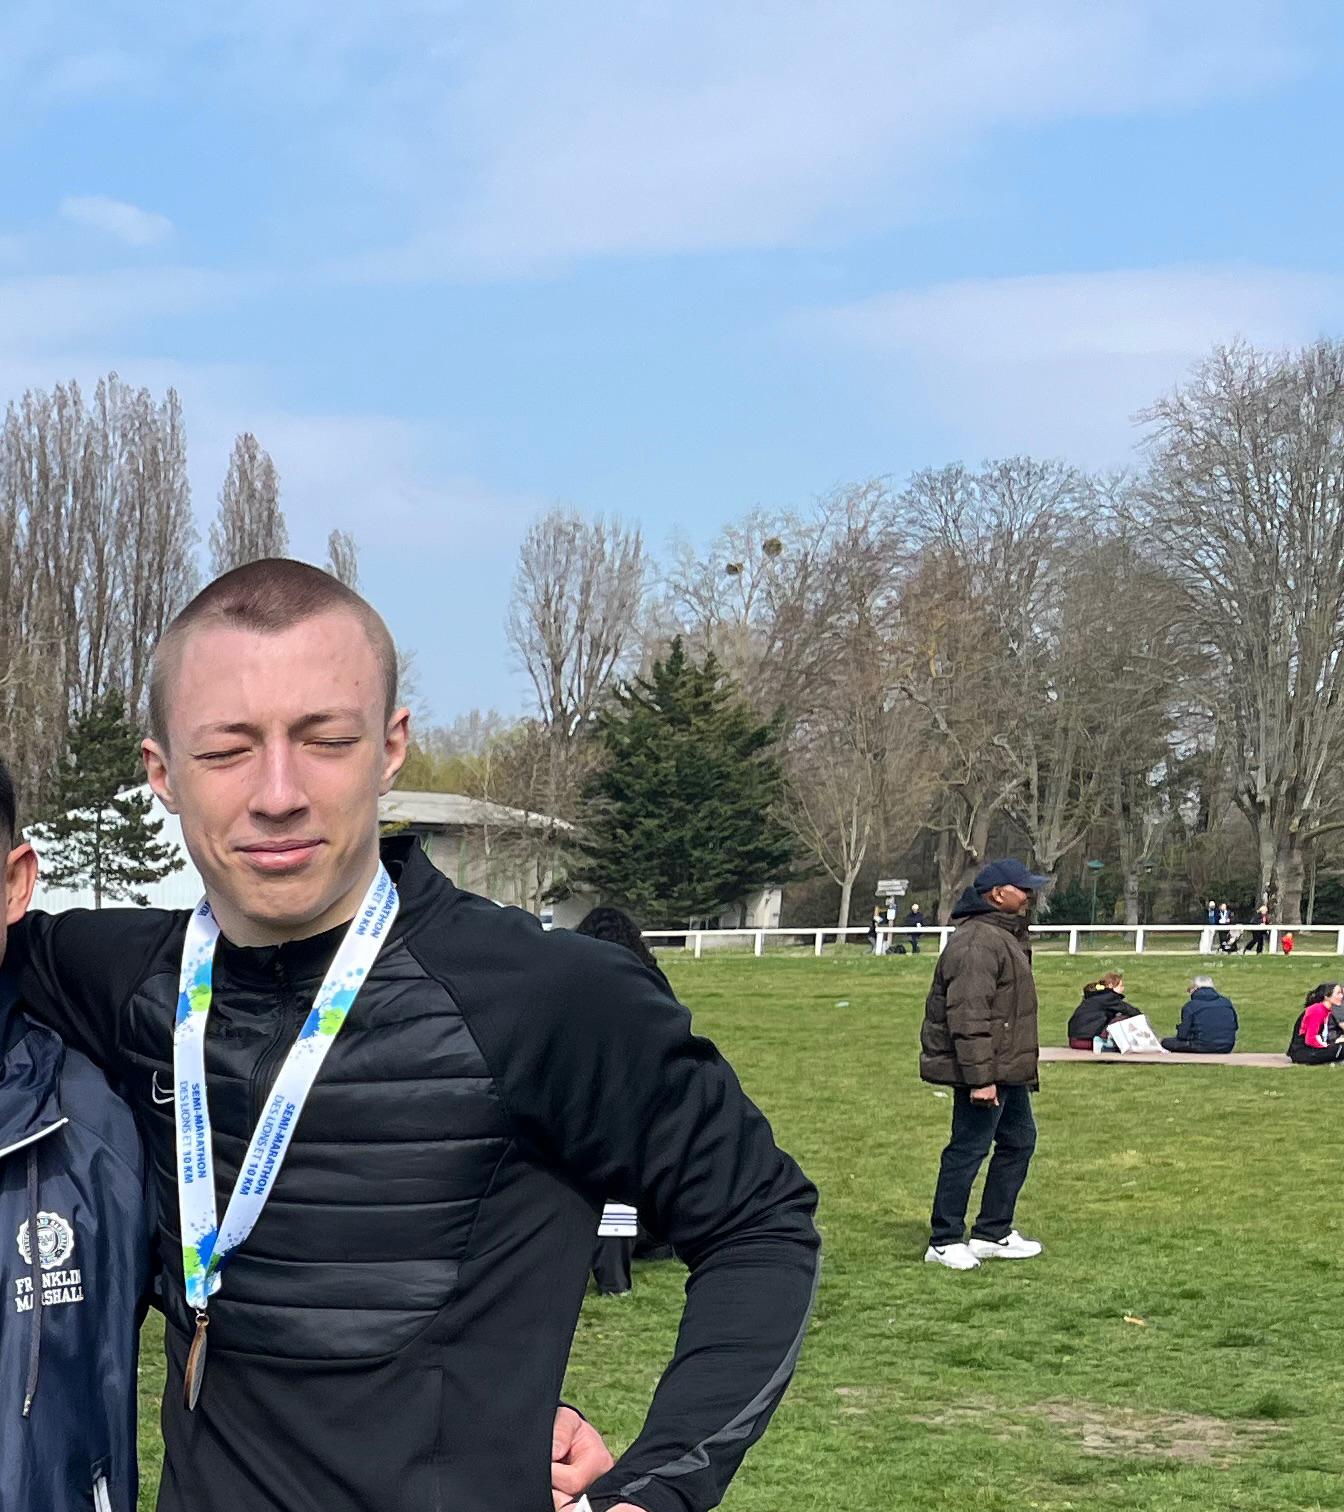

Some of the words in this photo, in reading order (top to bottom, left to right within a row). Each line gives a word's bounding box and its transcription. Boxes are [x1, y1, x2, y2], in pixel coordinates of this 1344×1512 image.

[180, 1080, 190, 1102] DES
[272, 1094, 285, 1116] DES
[180, 1102, 192, 1135] LIONS
[182, 1135, 192, 1148] ET
[192, 1082, 208, 1180] SEMI-MARATHON
[257, 1115, 276, 1147] LIONS
[183, 1151, 192, 1164] 10
[253, 1147, 265, 1161] ET
[254, 1102, 296, 1195] SEMI-MARATHON
[184, 1165, 194, 1184] KM
[247, 1163, 259, 1176] 10
[240, 1177, 254, 1196] KM
[15, 1268, 82, 1295] FRNKLI
